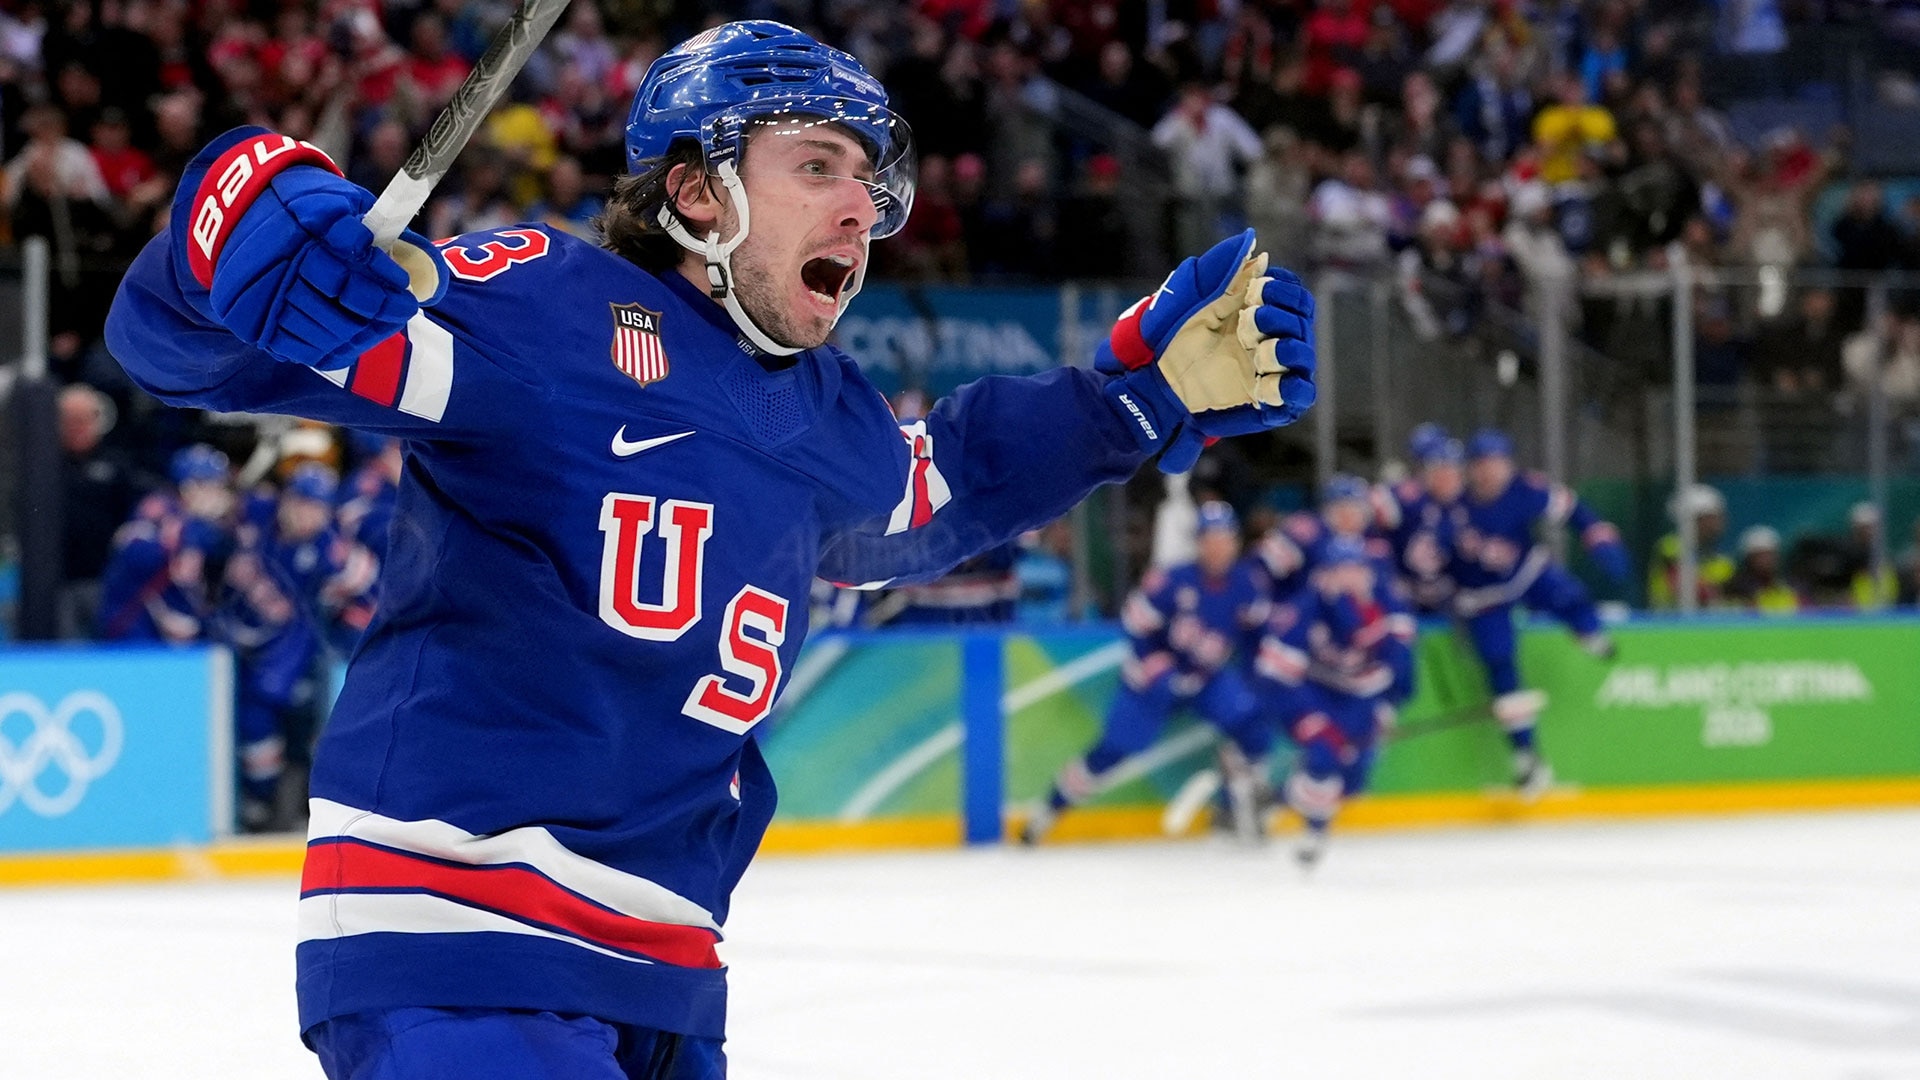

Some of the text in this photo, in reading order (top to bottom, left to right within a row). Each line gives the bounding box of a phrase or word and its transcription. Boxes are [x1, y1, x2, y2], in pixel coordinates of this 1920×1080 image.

[431, 228, 551, 283] 3
[620, 309, 654, 331] USA
[736, 339, 757, 357] USA
